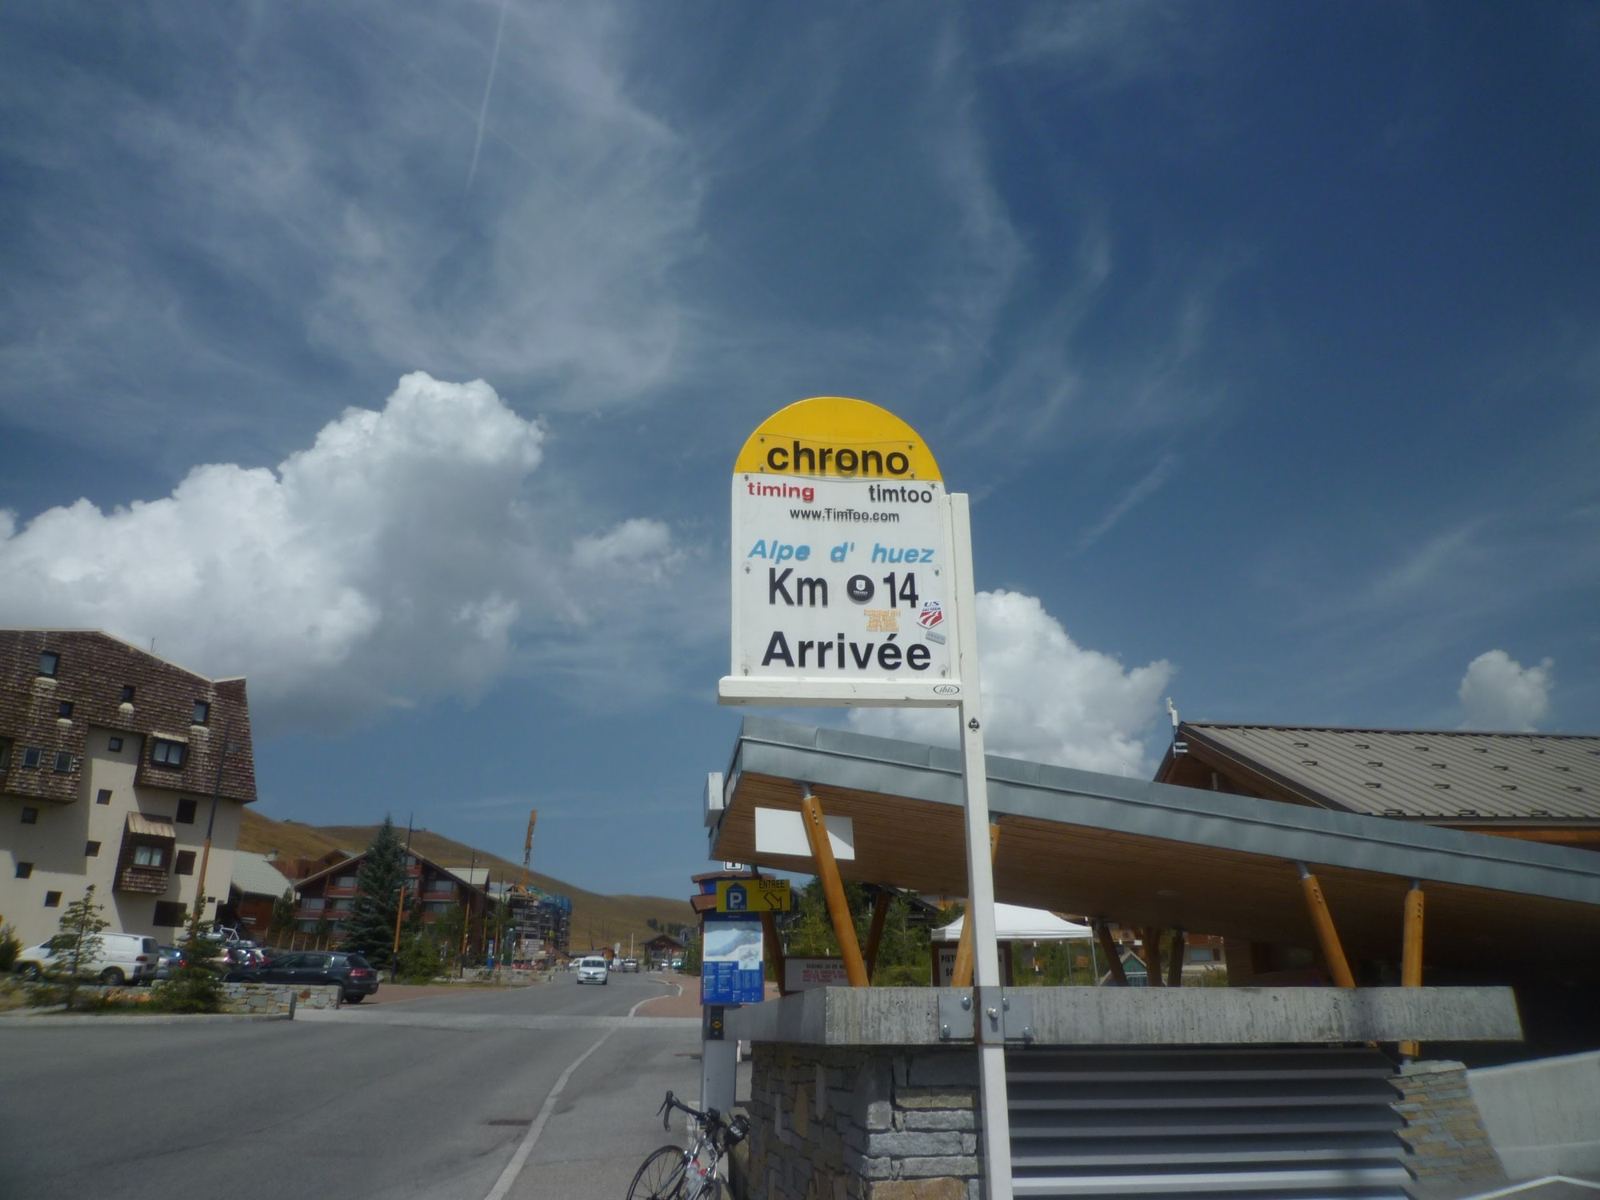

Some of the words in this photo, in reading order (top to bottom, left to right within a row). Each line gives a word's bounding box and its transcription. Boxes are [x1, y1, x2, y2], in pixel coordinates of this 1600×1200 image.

[767, 441, 909, 475] chrono
[747, 482, 815, 502] timing
[869, 485, 933, 503] timtoo
[789, 508, 900, 523] www.TimToo.com
[747, 539, 811, 565] Alpe
[830, 541, 855, 563] d'
[871, 542, 935, 564] huez
[769, 567, 829, 607] Km
[882, 572, 919, 609] 14
[761, 631, 931, 670] Arrivée
[729, 892, 742, 909] P
